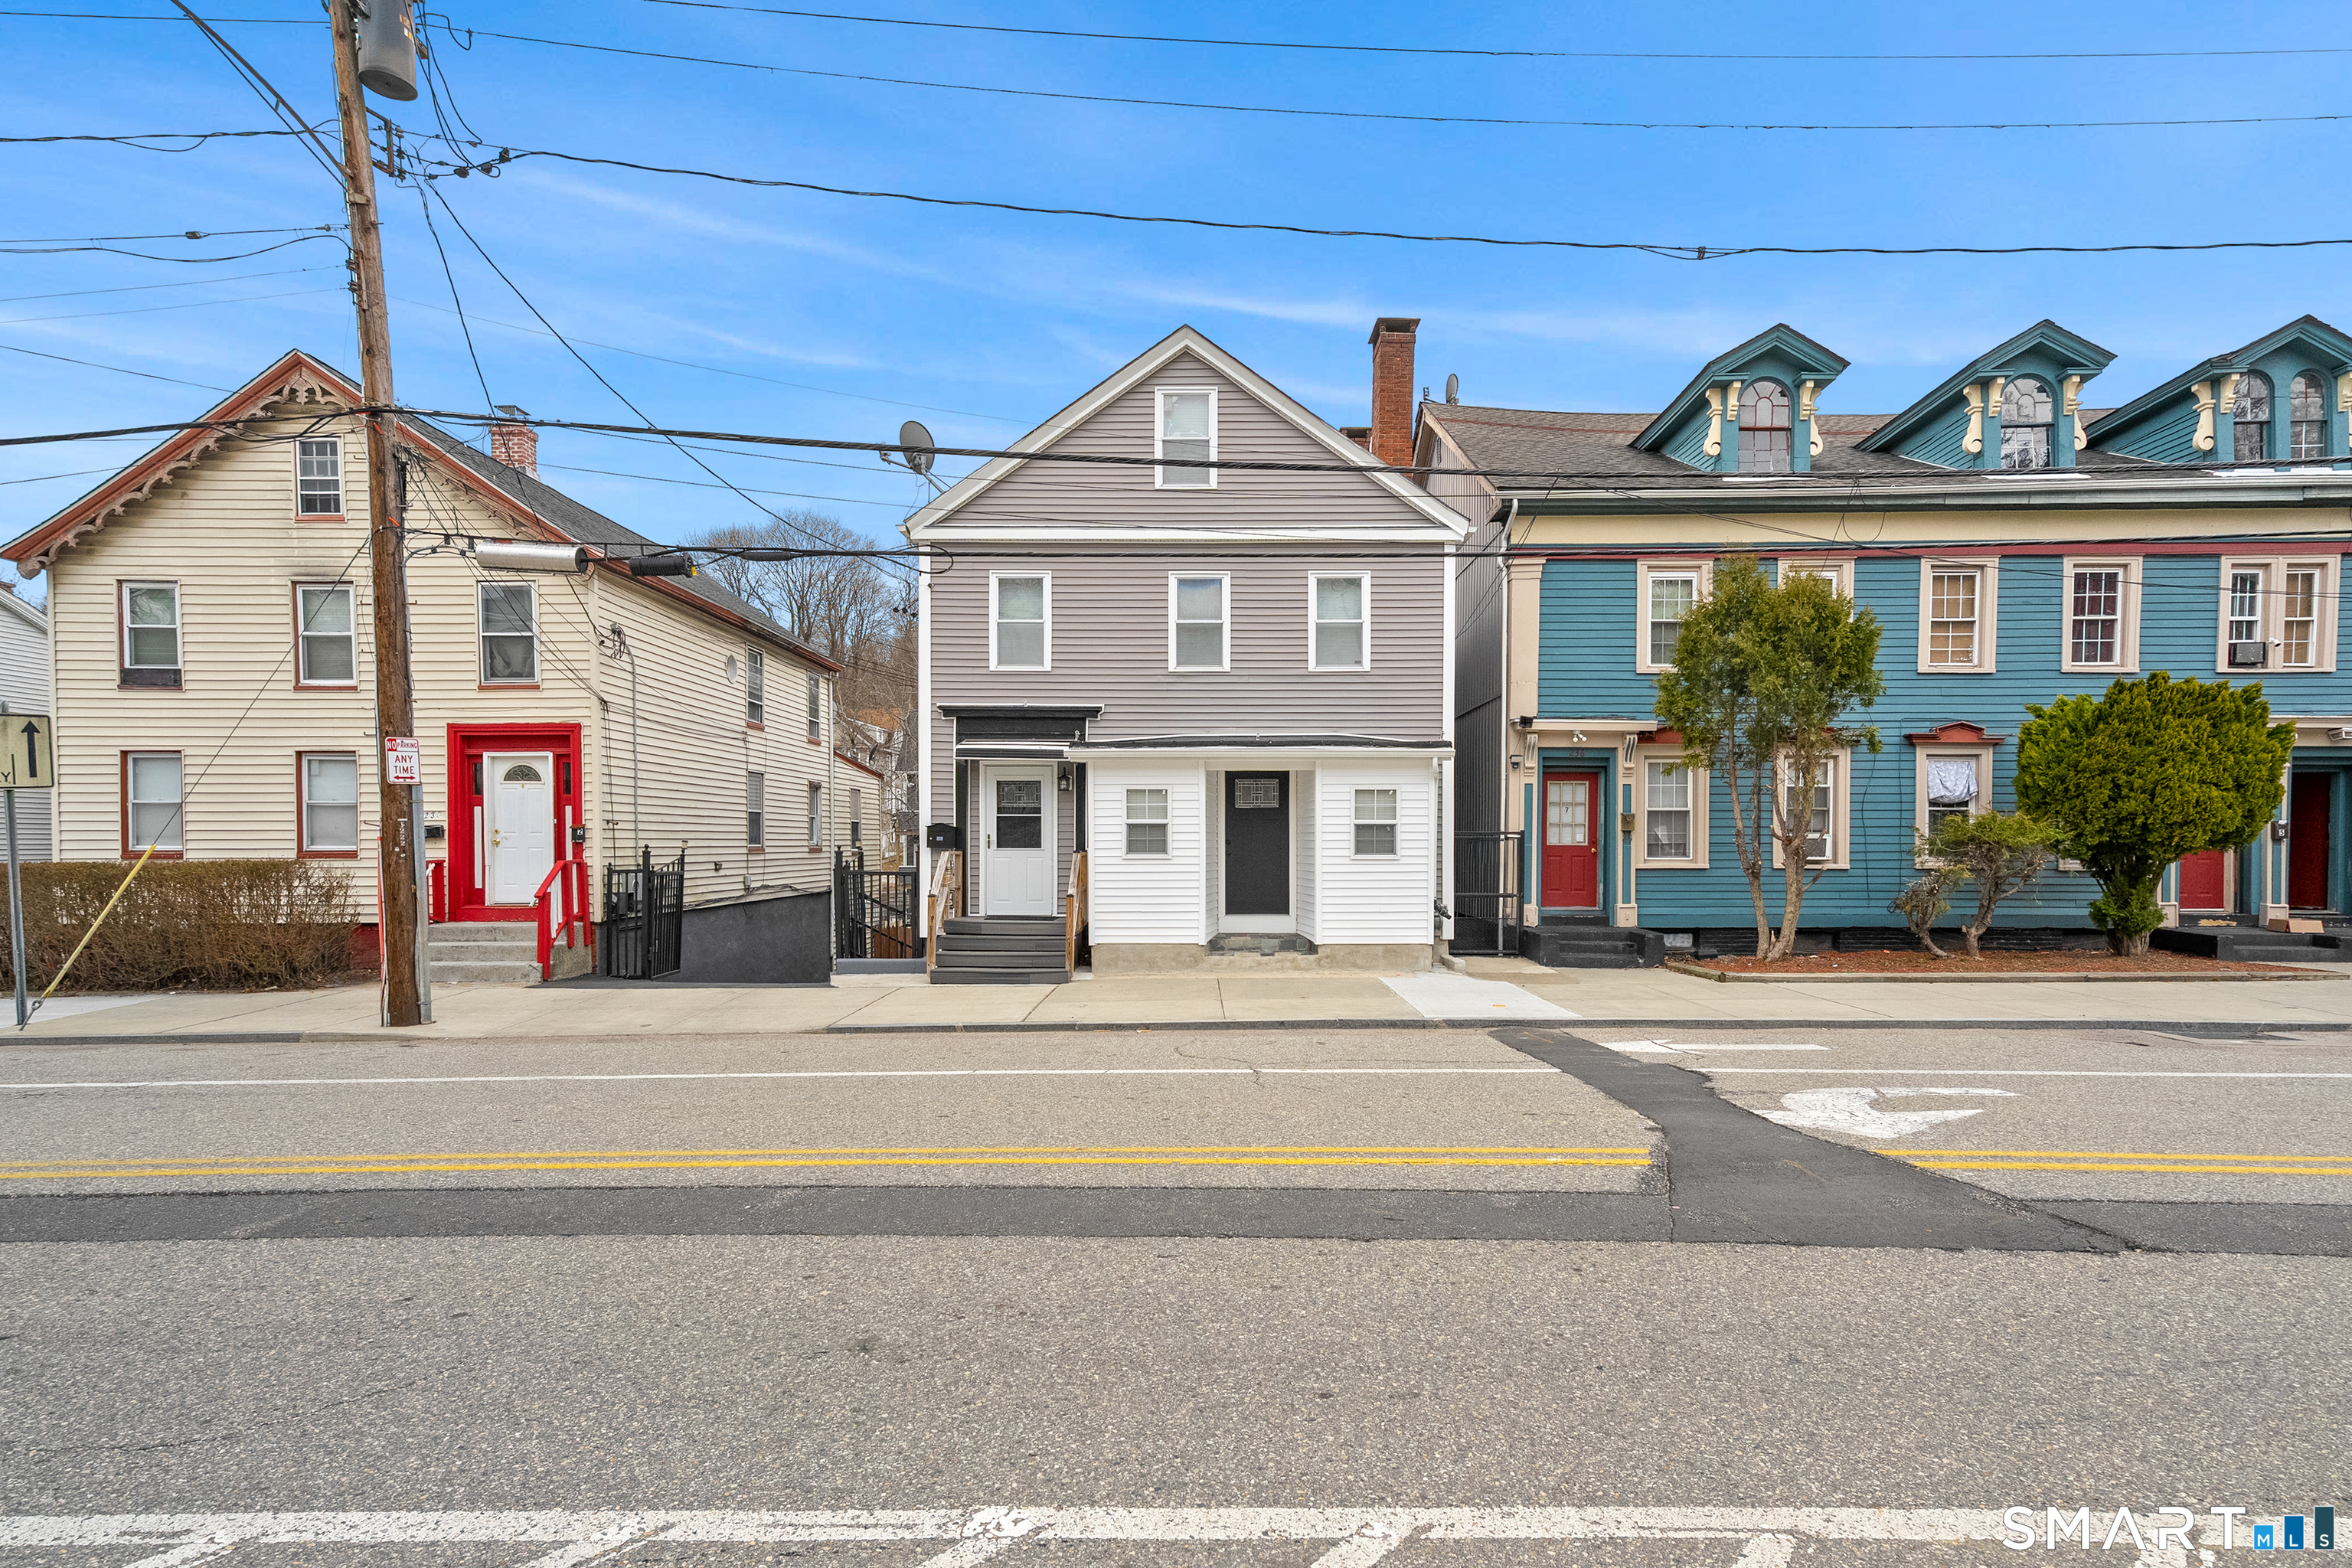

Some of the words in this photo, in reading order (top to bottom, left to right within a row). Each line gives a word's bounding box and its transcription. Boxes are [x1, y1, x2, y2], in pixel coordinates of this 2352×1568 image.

[387, 740, 397, 750] NO
[1570, 749, 1585, 758] 236
[394, 754, 413, 763] ANY
[394, 766, 415, 775] TIME
